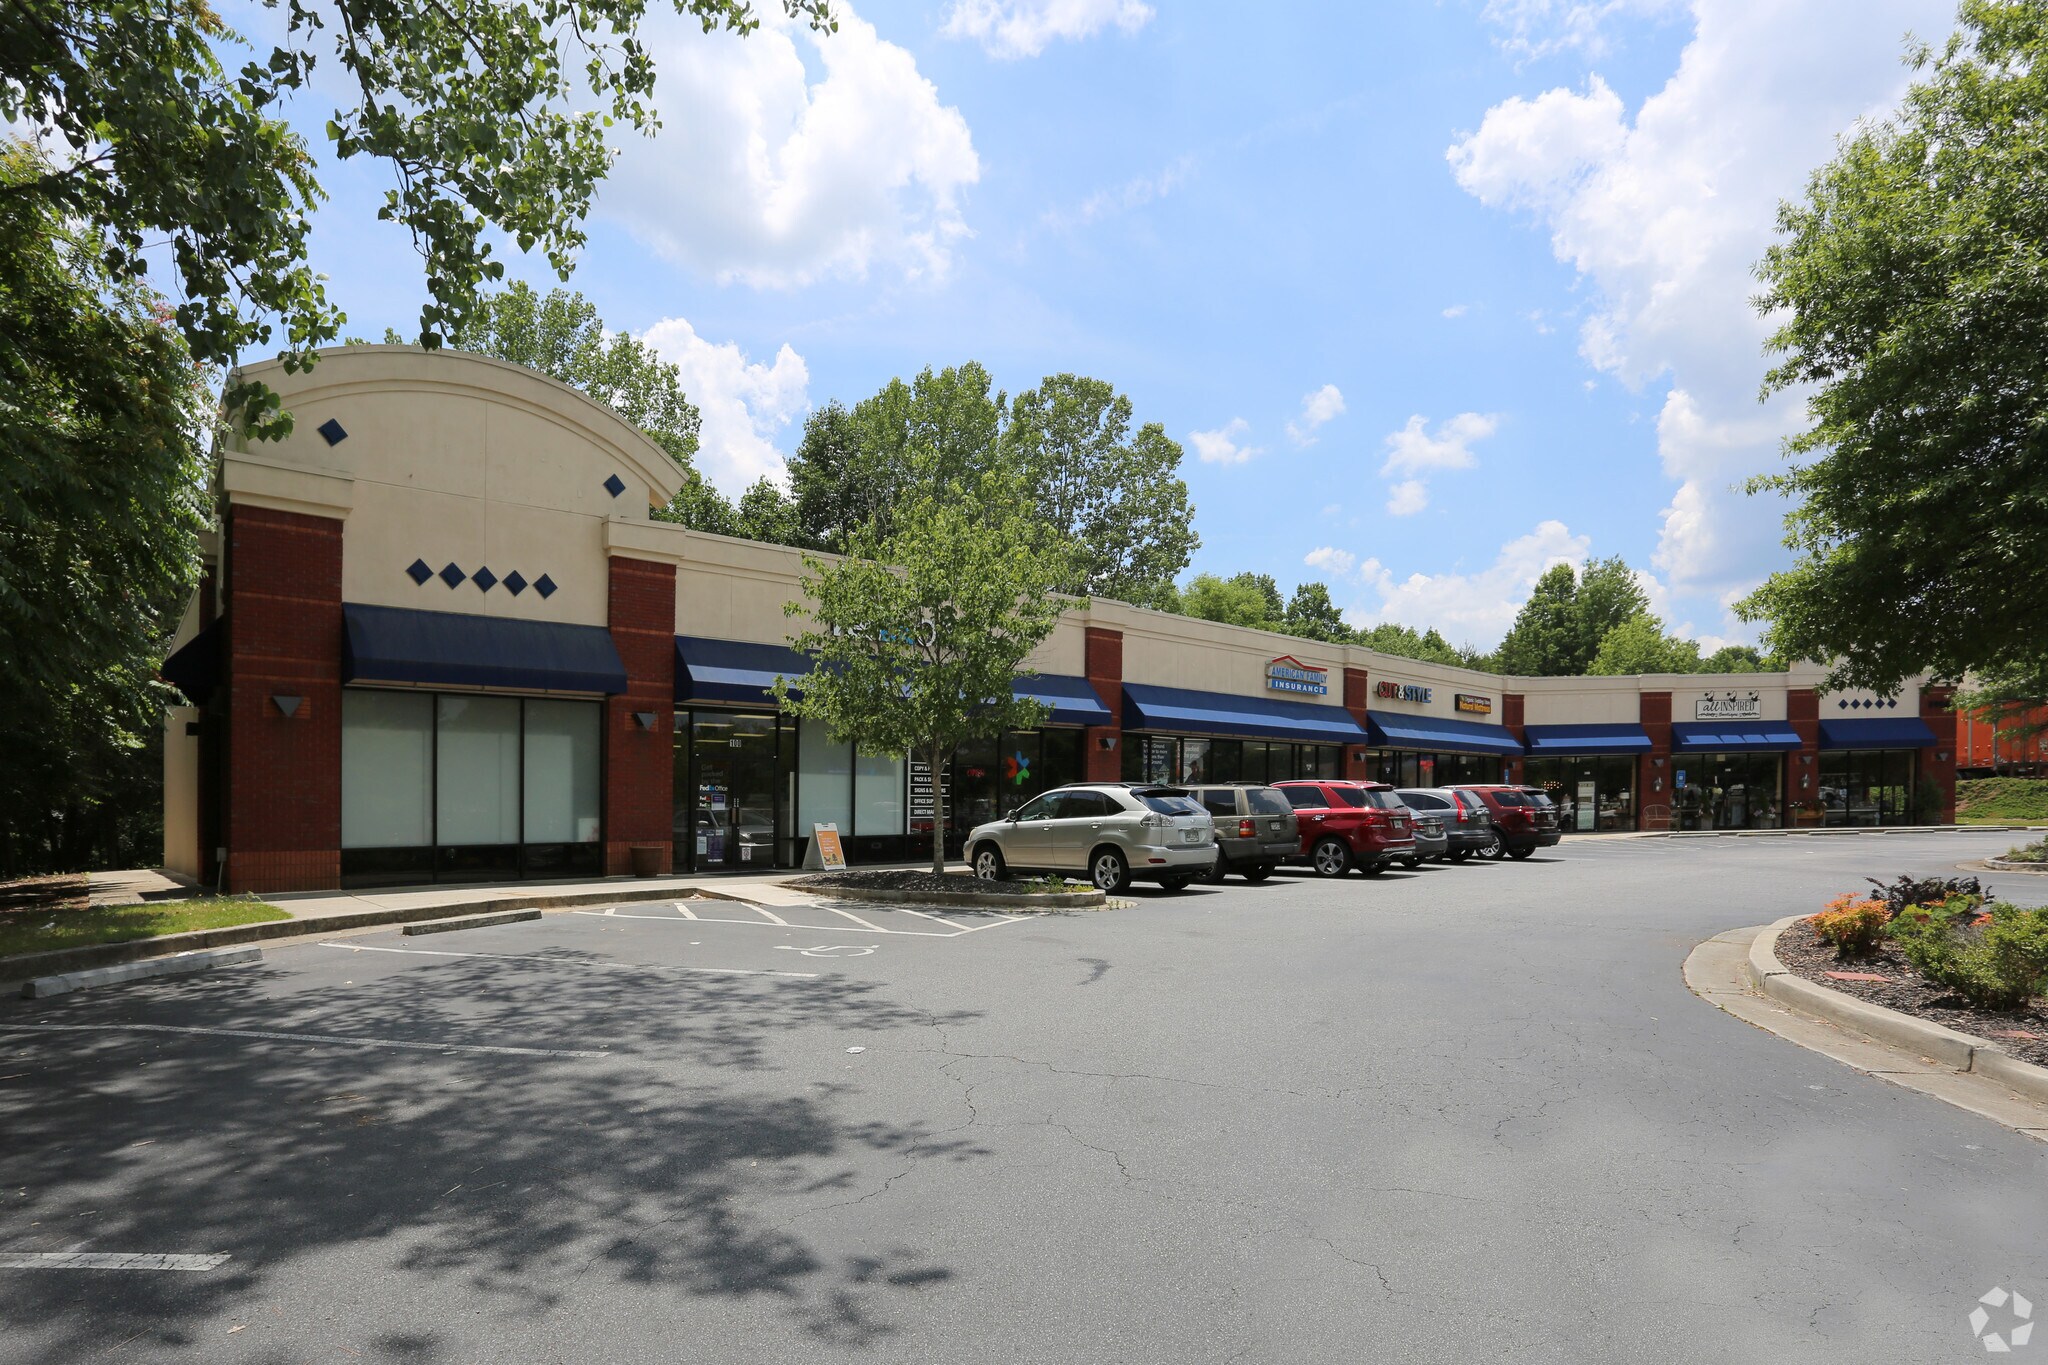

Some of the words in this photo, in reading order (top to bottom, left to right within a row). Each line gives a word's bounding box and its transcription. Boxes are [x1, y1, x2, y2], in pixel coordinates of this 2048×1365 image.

[1271, 666, 1304, 680] AMERICAN
[1306, 672, 1328, 683] FAMILY
[1275, 681, 1324, 693] INSURANCE
[1721, 701, 1755, 711] INSPIRED
